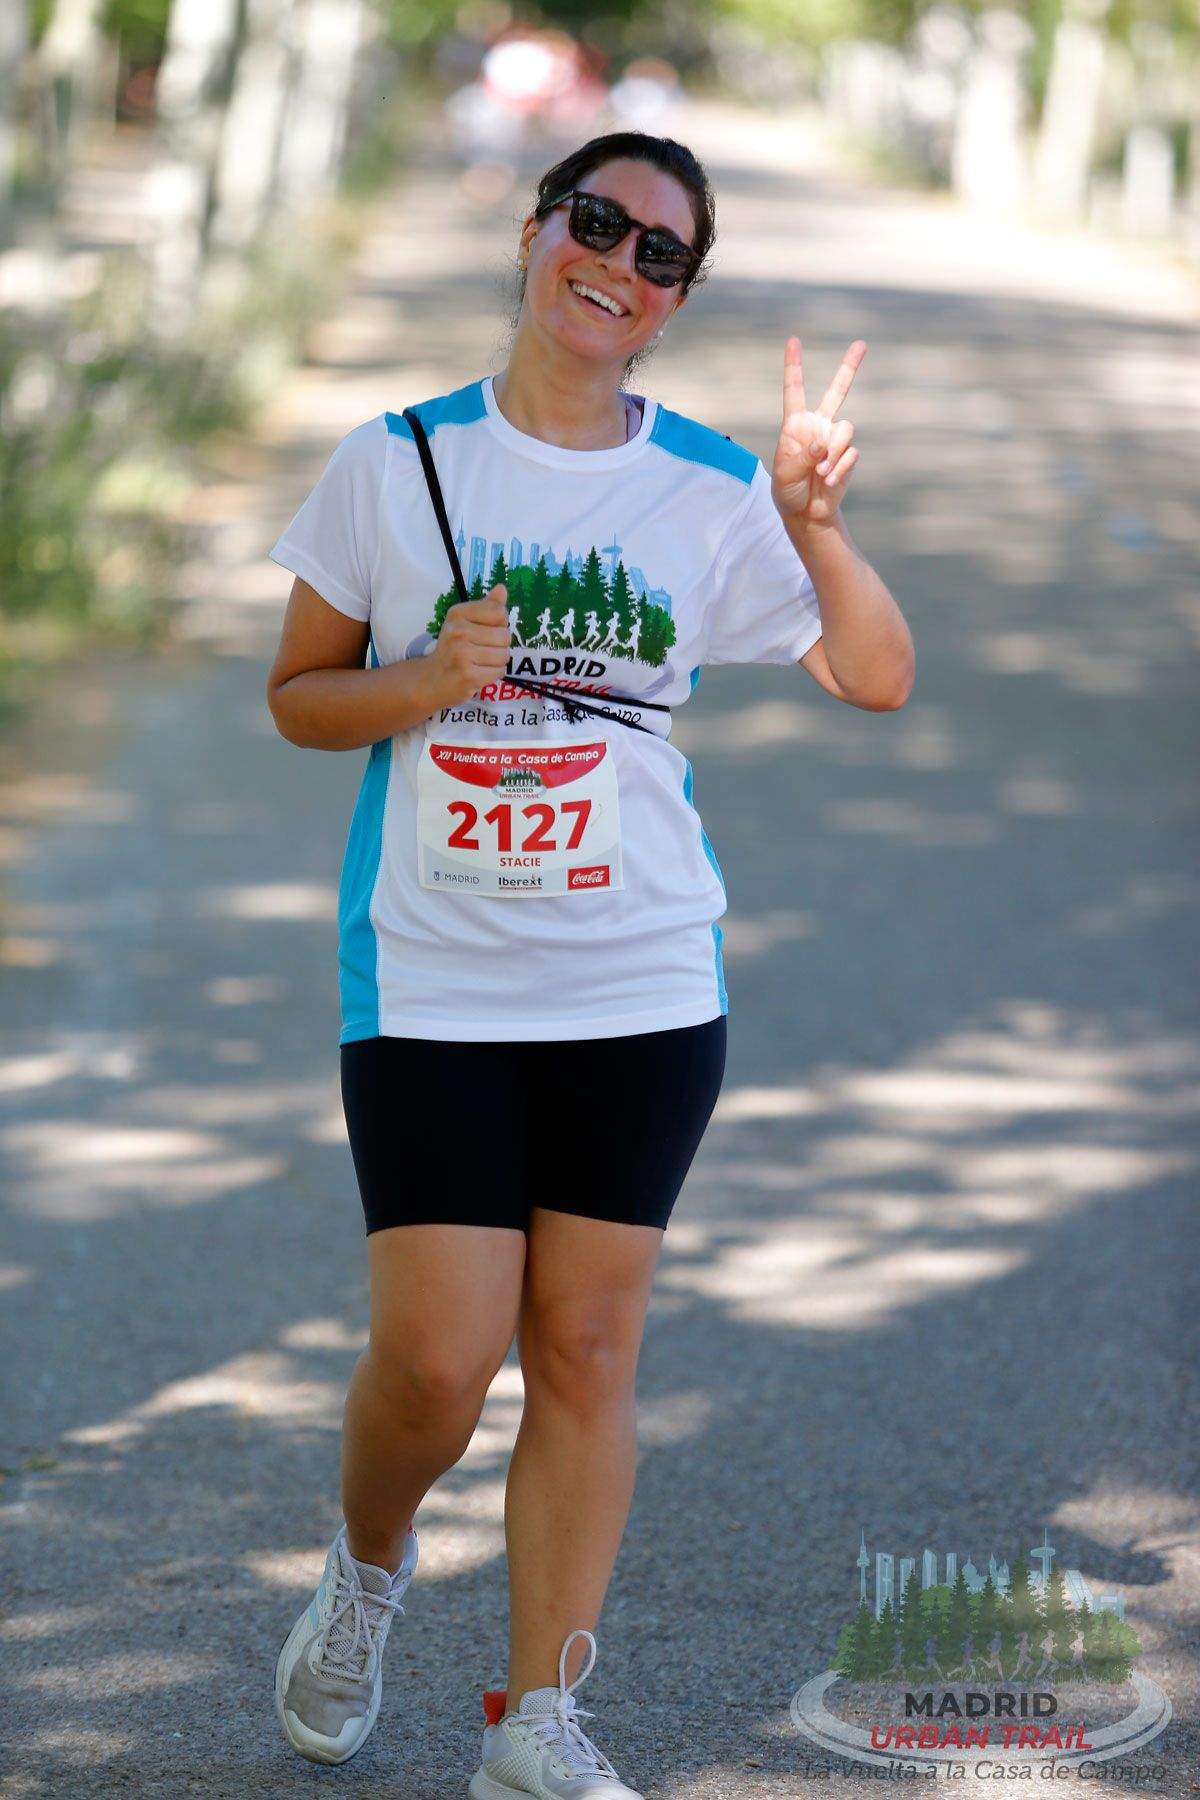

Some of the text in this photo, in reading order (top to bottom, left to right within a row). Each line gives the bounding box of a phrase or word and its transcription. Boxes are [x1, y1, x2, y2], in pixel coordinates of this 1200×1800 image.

[506, 656, 606, 678] ADRID
[440, 708, 499, 727] Vuelta
[504, 713, 514, 726] a
[522, 709, 538, 726] la
[436, 750, 599, 764] XII Vuelta a la Casa de Campo
[446, 799, 592, 853] 2127
[500, 857, 541, 867] STACIE
[444, 873, 480, 885] MADRID
